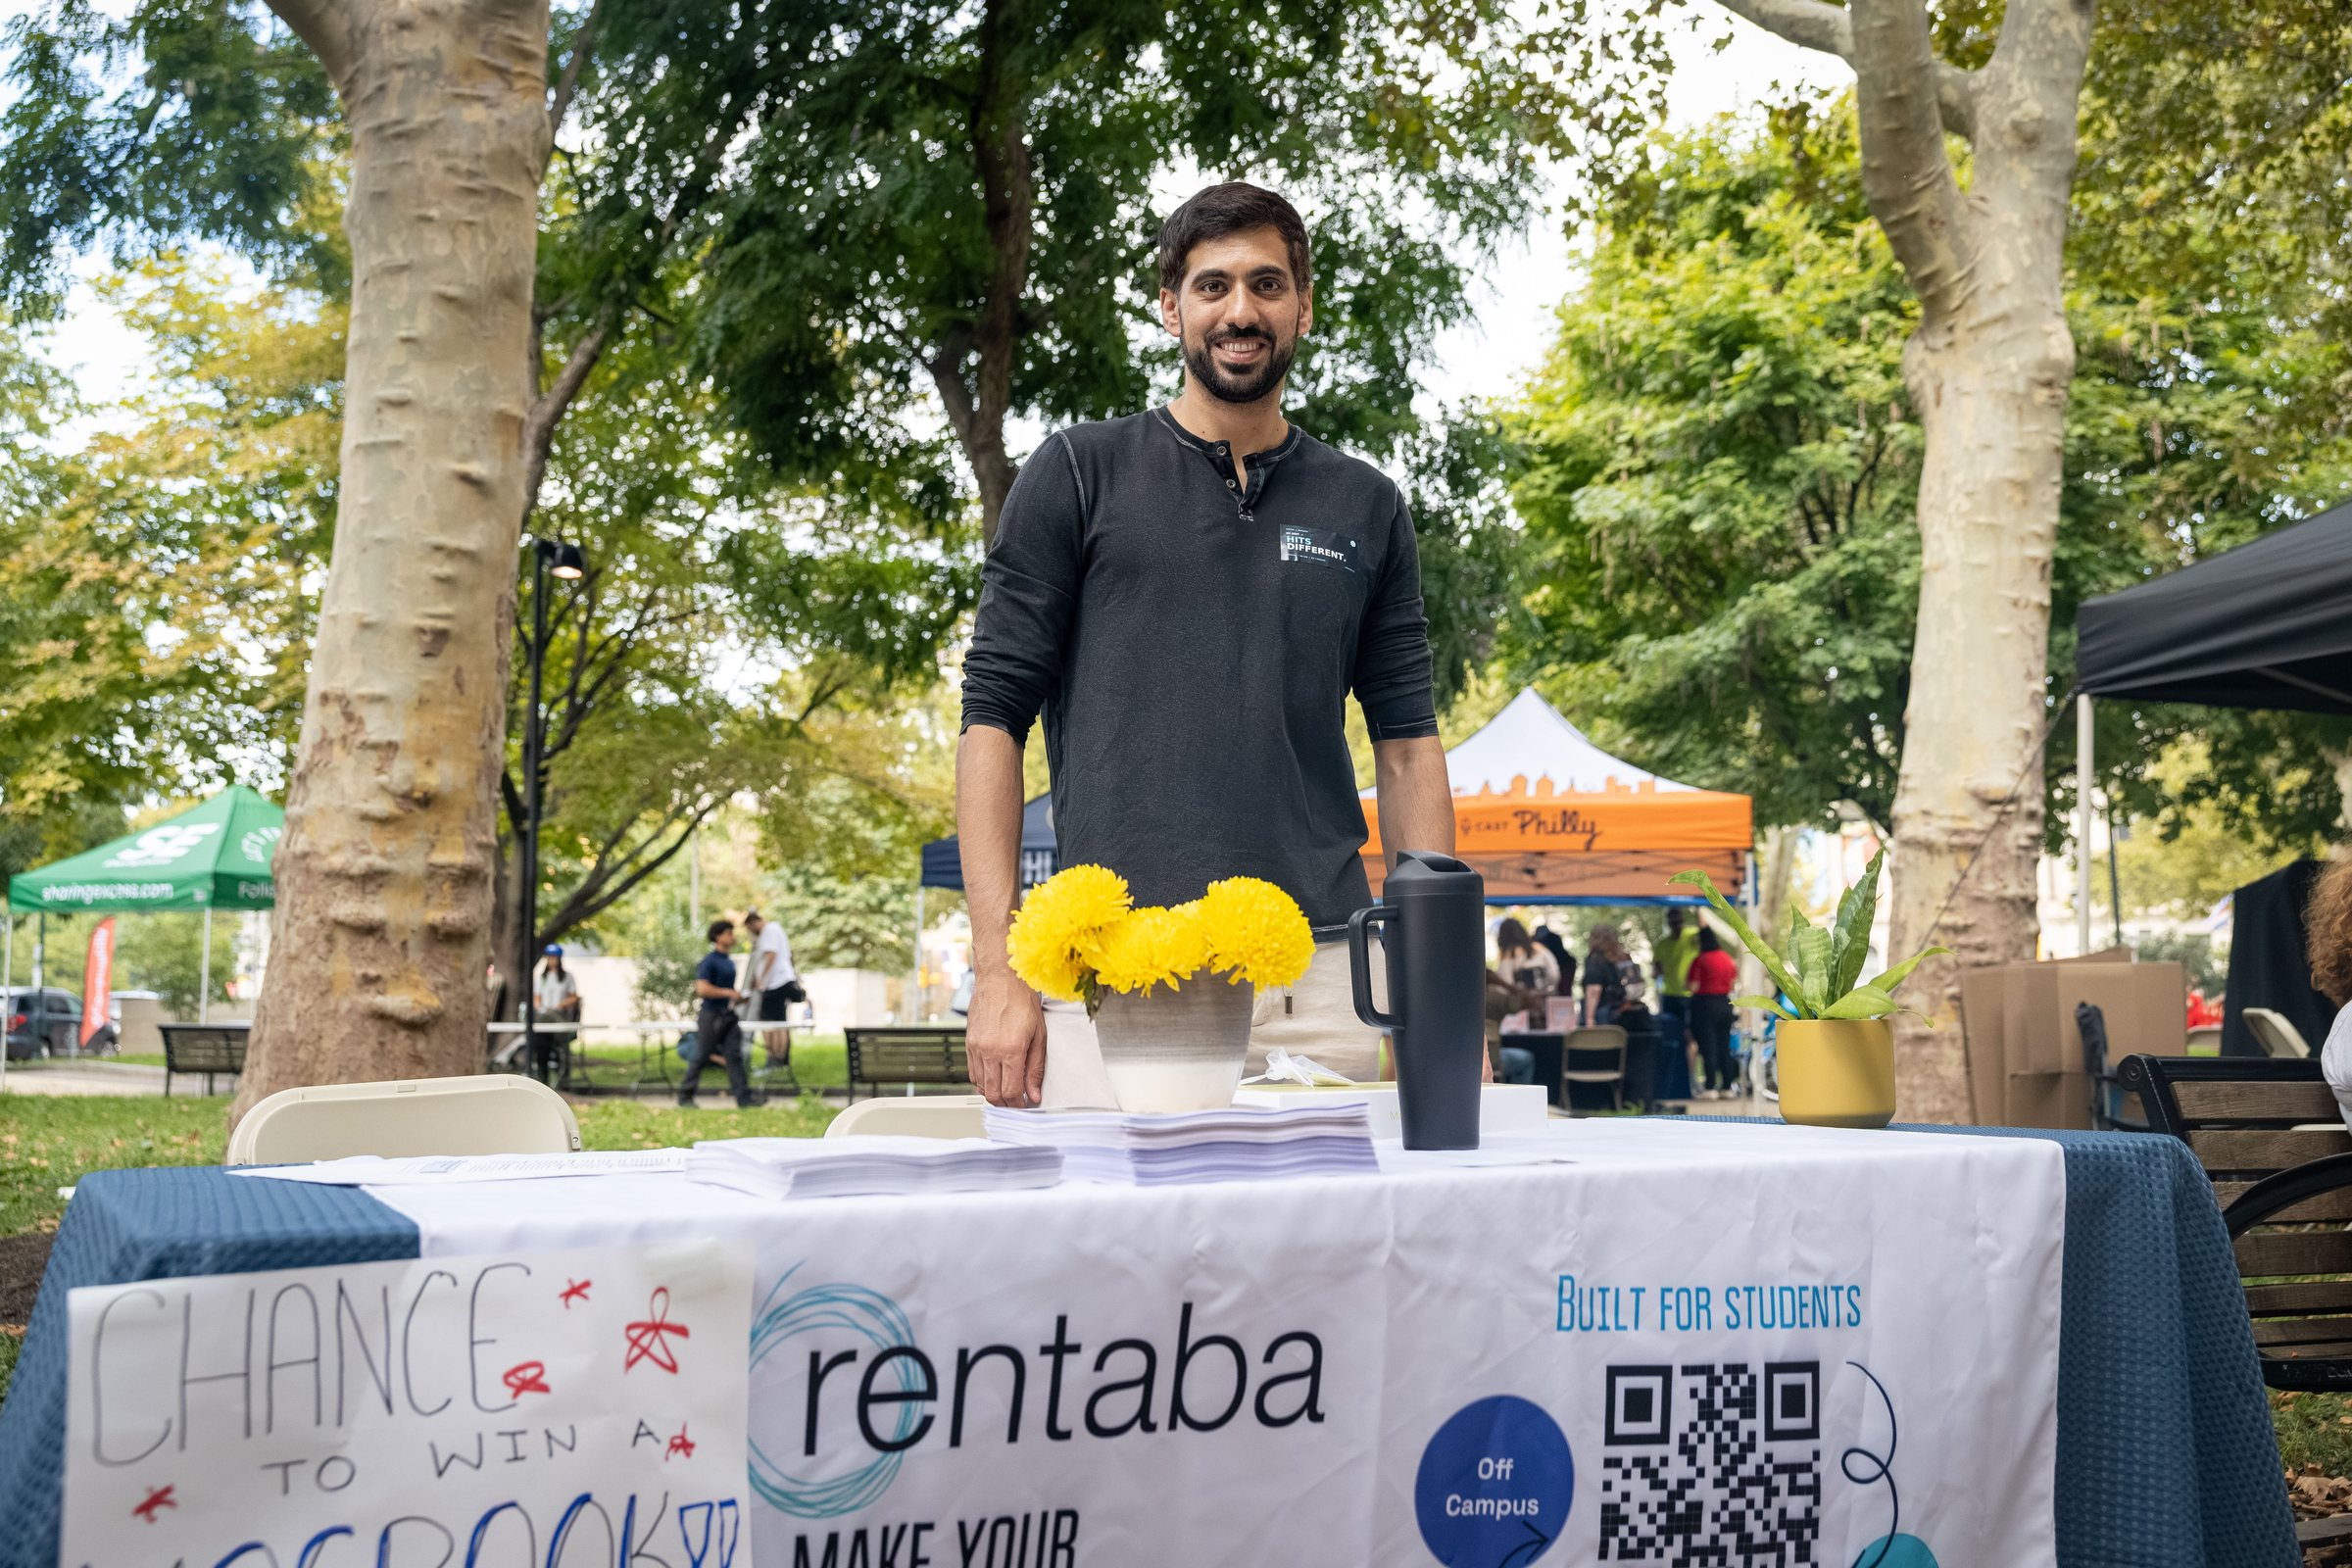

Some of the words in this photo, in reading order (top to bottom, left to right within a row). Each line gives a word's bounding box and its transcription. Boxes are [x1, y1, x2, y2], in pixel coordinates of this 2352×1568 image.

[1286, 535, 1312, 546] HITS
[1287, 542, 1348, 563] DIFFERENT.
[1512, 808, 1603, 852] Philly
[92, 1262, 532, 1468] CHANCE
[804, 1300, 1326, 1457] rentaba
[261, 1454, 357, 1495] TO
[429, 1424, 578, 1480] WIN
[631, 1418, 662, 1447] A
[1476, 1456, 1515, 1481] Off
[1445, 1494, 1541, 1521] Campus
[792, 1522, 935, 1568] MAKE
[956, 1508, 1080, 1568] YOUR
